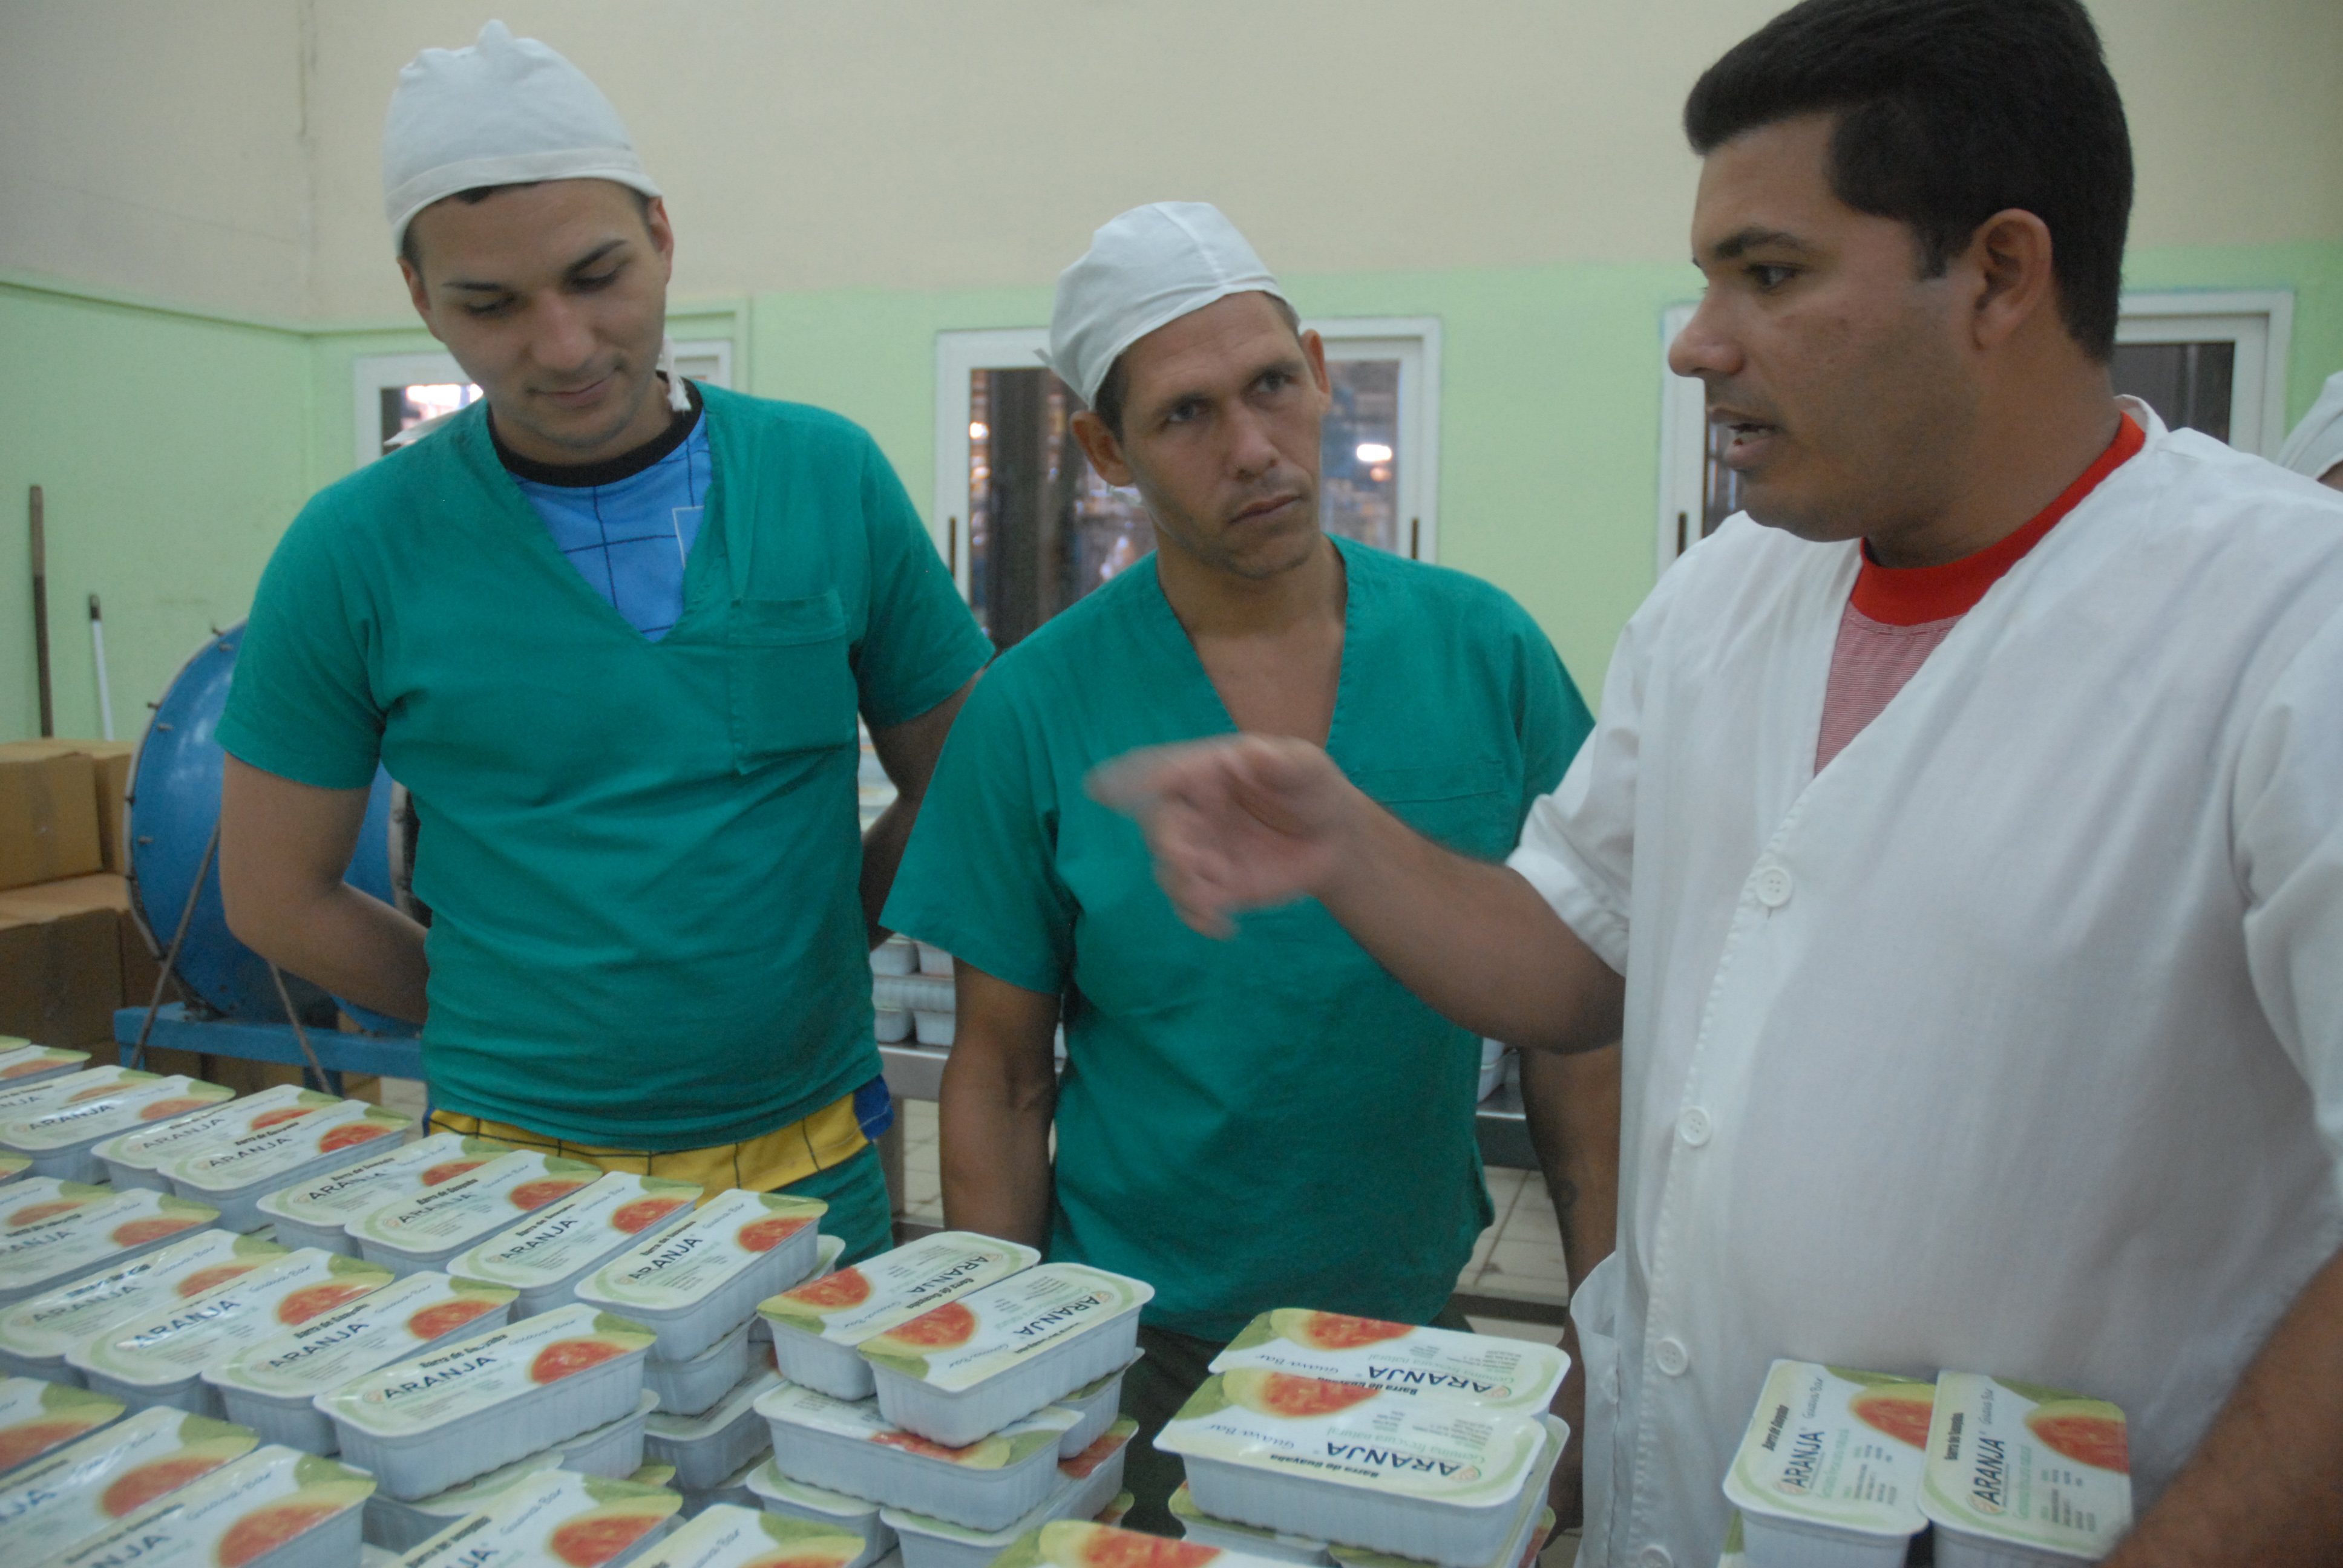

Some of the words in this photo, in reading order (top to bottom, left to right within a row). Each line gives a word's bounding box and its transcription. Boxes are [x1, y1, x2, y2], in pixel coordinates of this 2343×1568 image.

[143, 1117, 226, 1148] ARANJA
[209, 1137, 292, 1167] ARANJA
[500, 1218, 578, 1259] ARANJA
[628, 1238, 704, 1279] ARANJA
[907, 1256, 989, 1293] ARANJA
[1013, 1296, 1101, 1336] ARANJA
[269, 1323, 370, 1368] ARANJA
[384, 1356, 498, 1399] ARANJA
[1368, 1381, 1383, 1390] de
[1369, 1365, 1493, 1394] ARANJA
[1385, 1383, 1418, 1396] Barra
[1206, 1423, 1237, 1436] Bar
[1242, 1430, 1295, 1449] Guava
[1270, 1454, 1323, 1468] Guayaba
[1325, 1463, 1342, 1472] de
[1327, 1442, 1461, 1476] ARANJA
[1344, 1466, 1380, 1478] Barra
[1781, 1431, 1825, 1488] ARANJA
[1973, 1437, 2005, 1506] ARANJA
